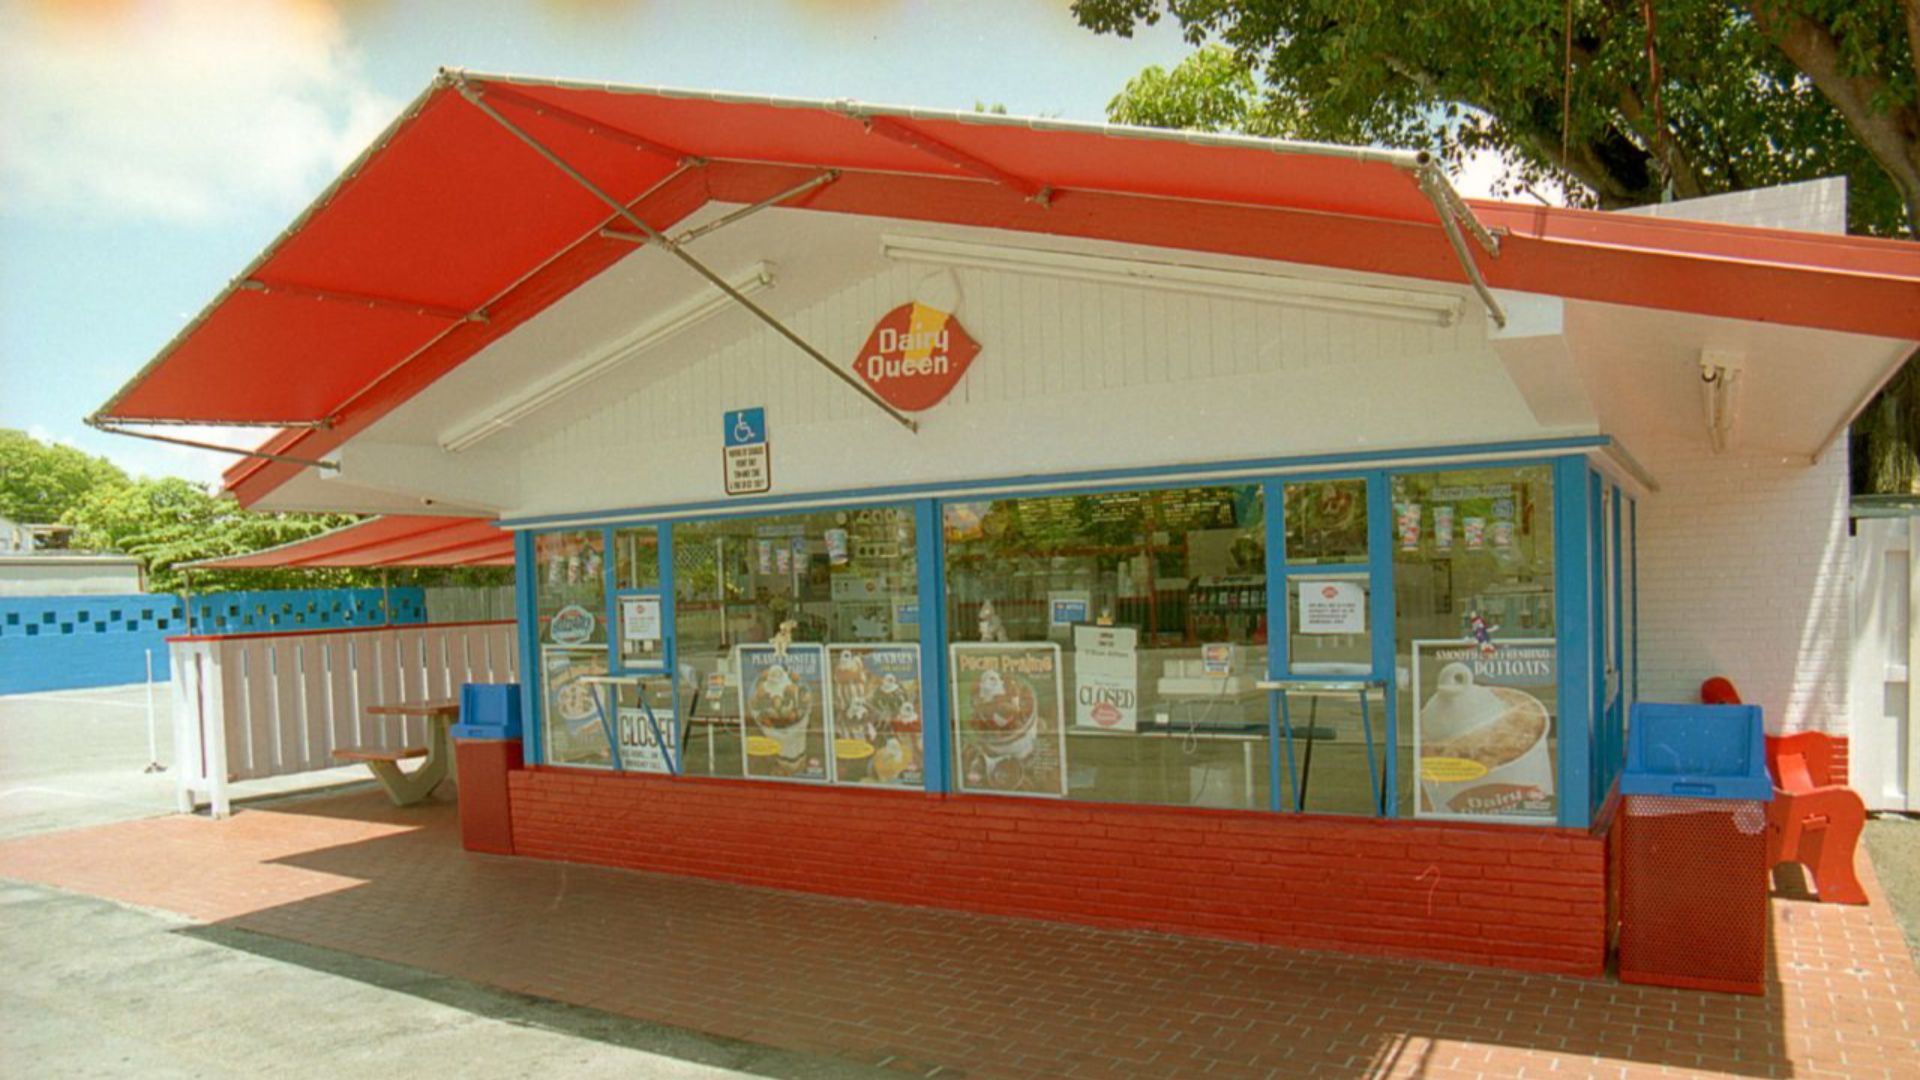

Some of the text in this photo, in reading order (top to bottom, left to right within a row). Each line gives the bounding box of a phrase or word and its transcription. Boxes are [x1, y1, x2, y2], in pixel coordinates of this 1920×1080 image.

[879, 328, 949, 353] Dairy
[867, 355, 949, 382] Queen
[1079, 685, 1135, 710] CLOSED
